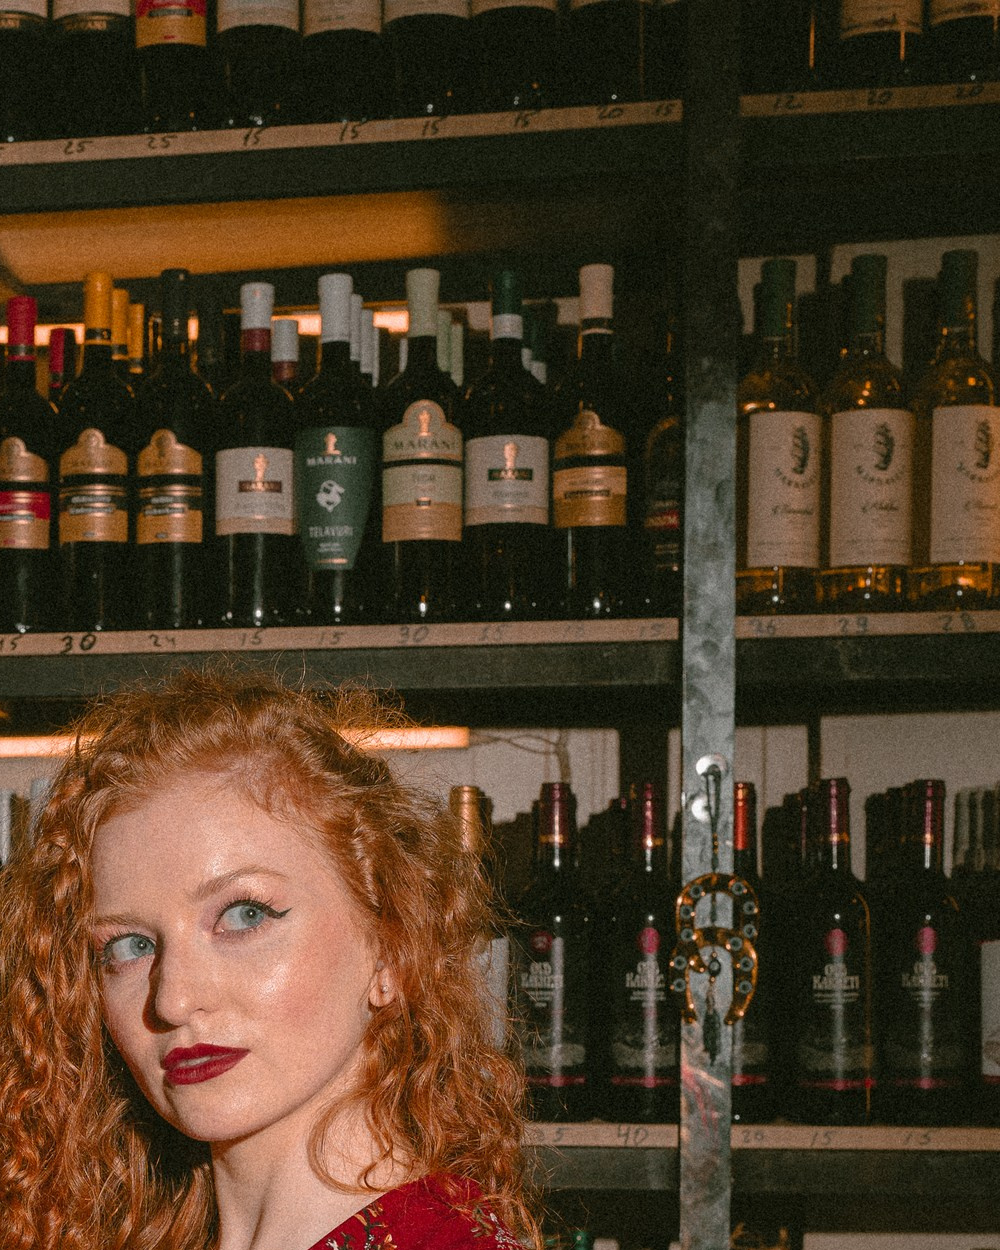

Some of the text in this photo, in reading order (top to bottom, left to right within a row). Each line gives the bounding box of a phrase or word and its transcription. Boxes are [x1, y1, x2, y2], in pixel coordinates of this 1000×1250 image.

[600, 107, 624, 121] 20
[339, 120, 368, 142] 15
[422, 116, 450, 137] 15
[63, 140, 93, 156] 25
[147, 135, 178, 150] 25
[393, 437, 454, 450] MARANI
[305, 455, 356, 466] MARANI
[61, 634, 96, 655] 30
[148, 633, 175, 648] 24
[240, 627, 267, 647] 15
[318, 630, 345, 644] 15
[617, 1125, 648, 1146] 40
[810, 1130, 836, 1147] 15
